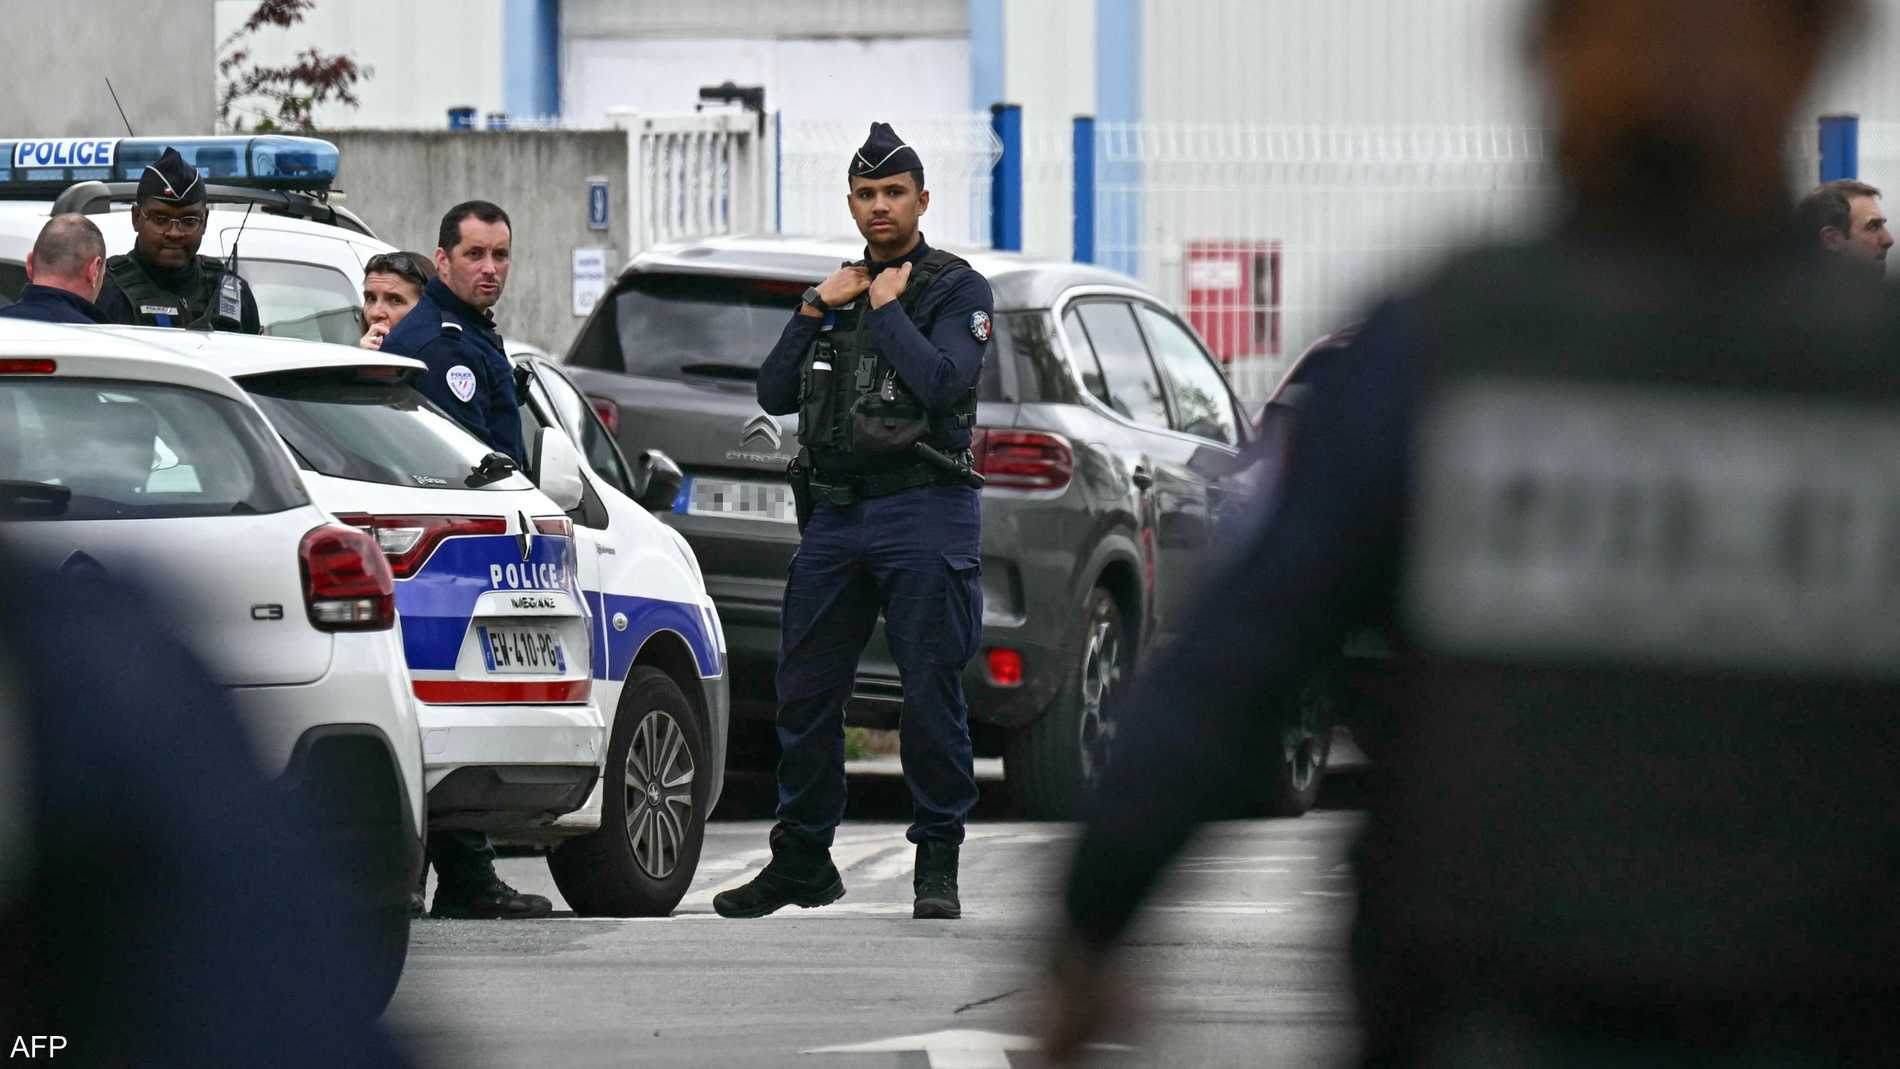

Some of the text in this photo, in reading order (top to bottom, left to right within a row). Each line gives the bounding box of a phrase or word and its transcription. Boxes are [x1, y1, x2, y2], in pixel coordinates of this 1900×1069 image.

[18, 141, 112, 165] POLICE
[490, 563, 560, 589] POLICE
[251, 603, 284, 621] C3
[489, 632, 557, 667] EW-410-PG
